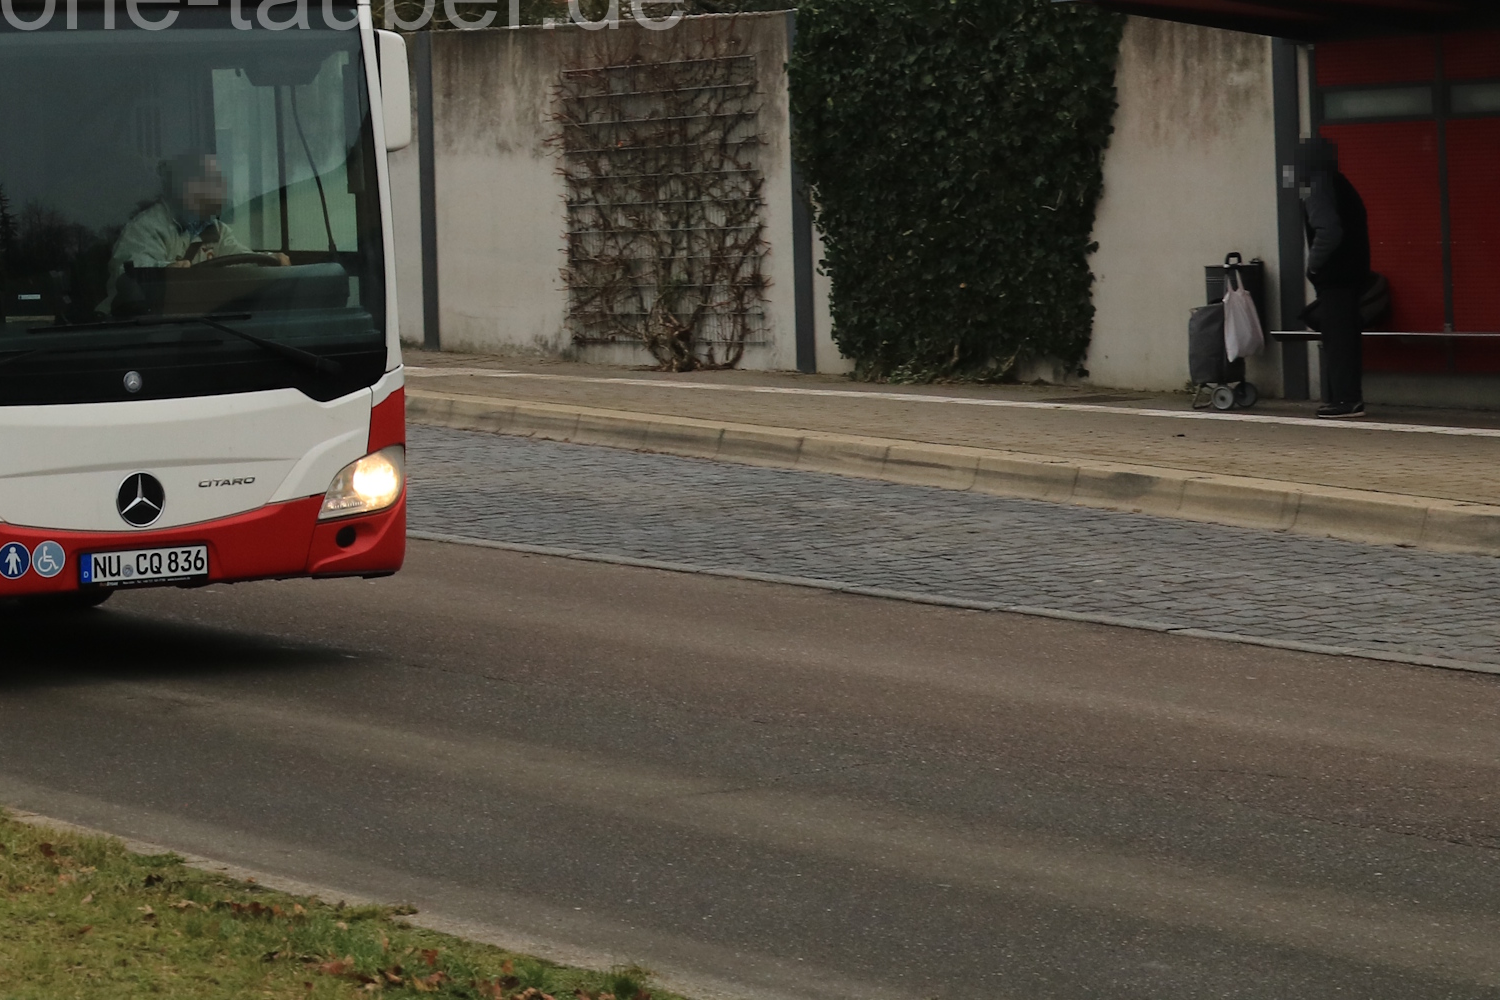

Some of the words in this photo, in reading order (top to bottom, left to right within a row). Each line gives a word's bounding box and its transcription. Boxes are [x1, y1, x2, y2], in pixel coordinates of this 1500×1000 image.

[198, 476, 256, 488] CITARO
[93, 554, 121, 579] NU
[135, 552, 162, 575] CQ
[167, 549, 205, 573] 836
